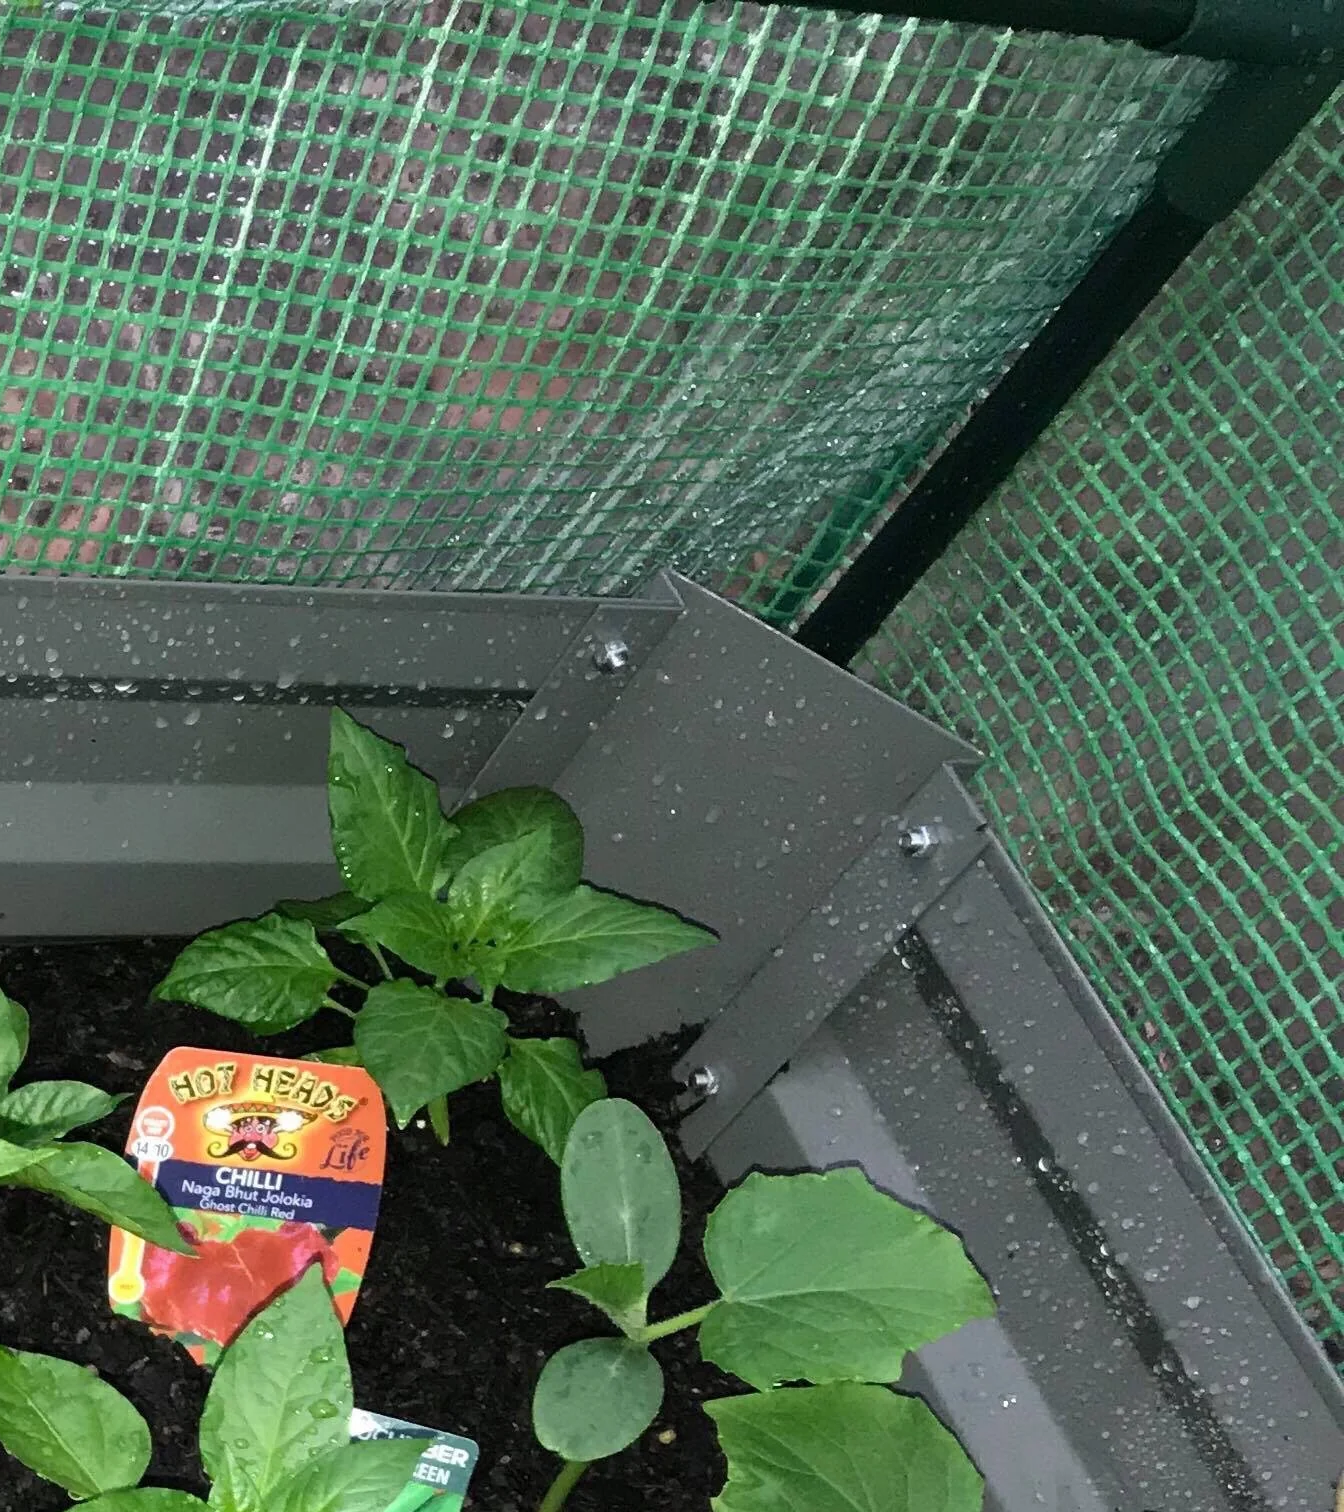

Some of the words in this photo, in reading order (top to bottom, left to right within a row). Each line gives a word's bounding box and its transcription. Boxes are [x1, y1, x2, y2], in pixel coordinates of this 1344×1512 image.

[168, 1062, 238, 1104] HOT
[252, 1063, 360, 1123] HEADS
[319, 1139, 371, 1170] Life
[215, 1167, 283, 1191] CHILLI
[182, 1180, 220, 1201] Naga
[224, 1183, 259, 1202] Bhut
[261, 1190, 314, 1209] Jolokia
[199, 1199, 236, 1213] Ghost
[238, 1203, 269, 1216] Chilli
[270, 1207, 296, 1220] Red
